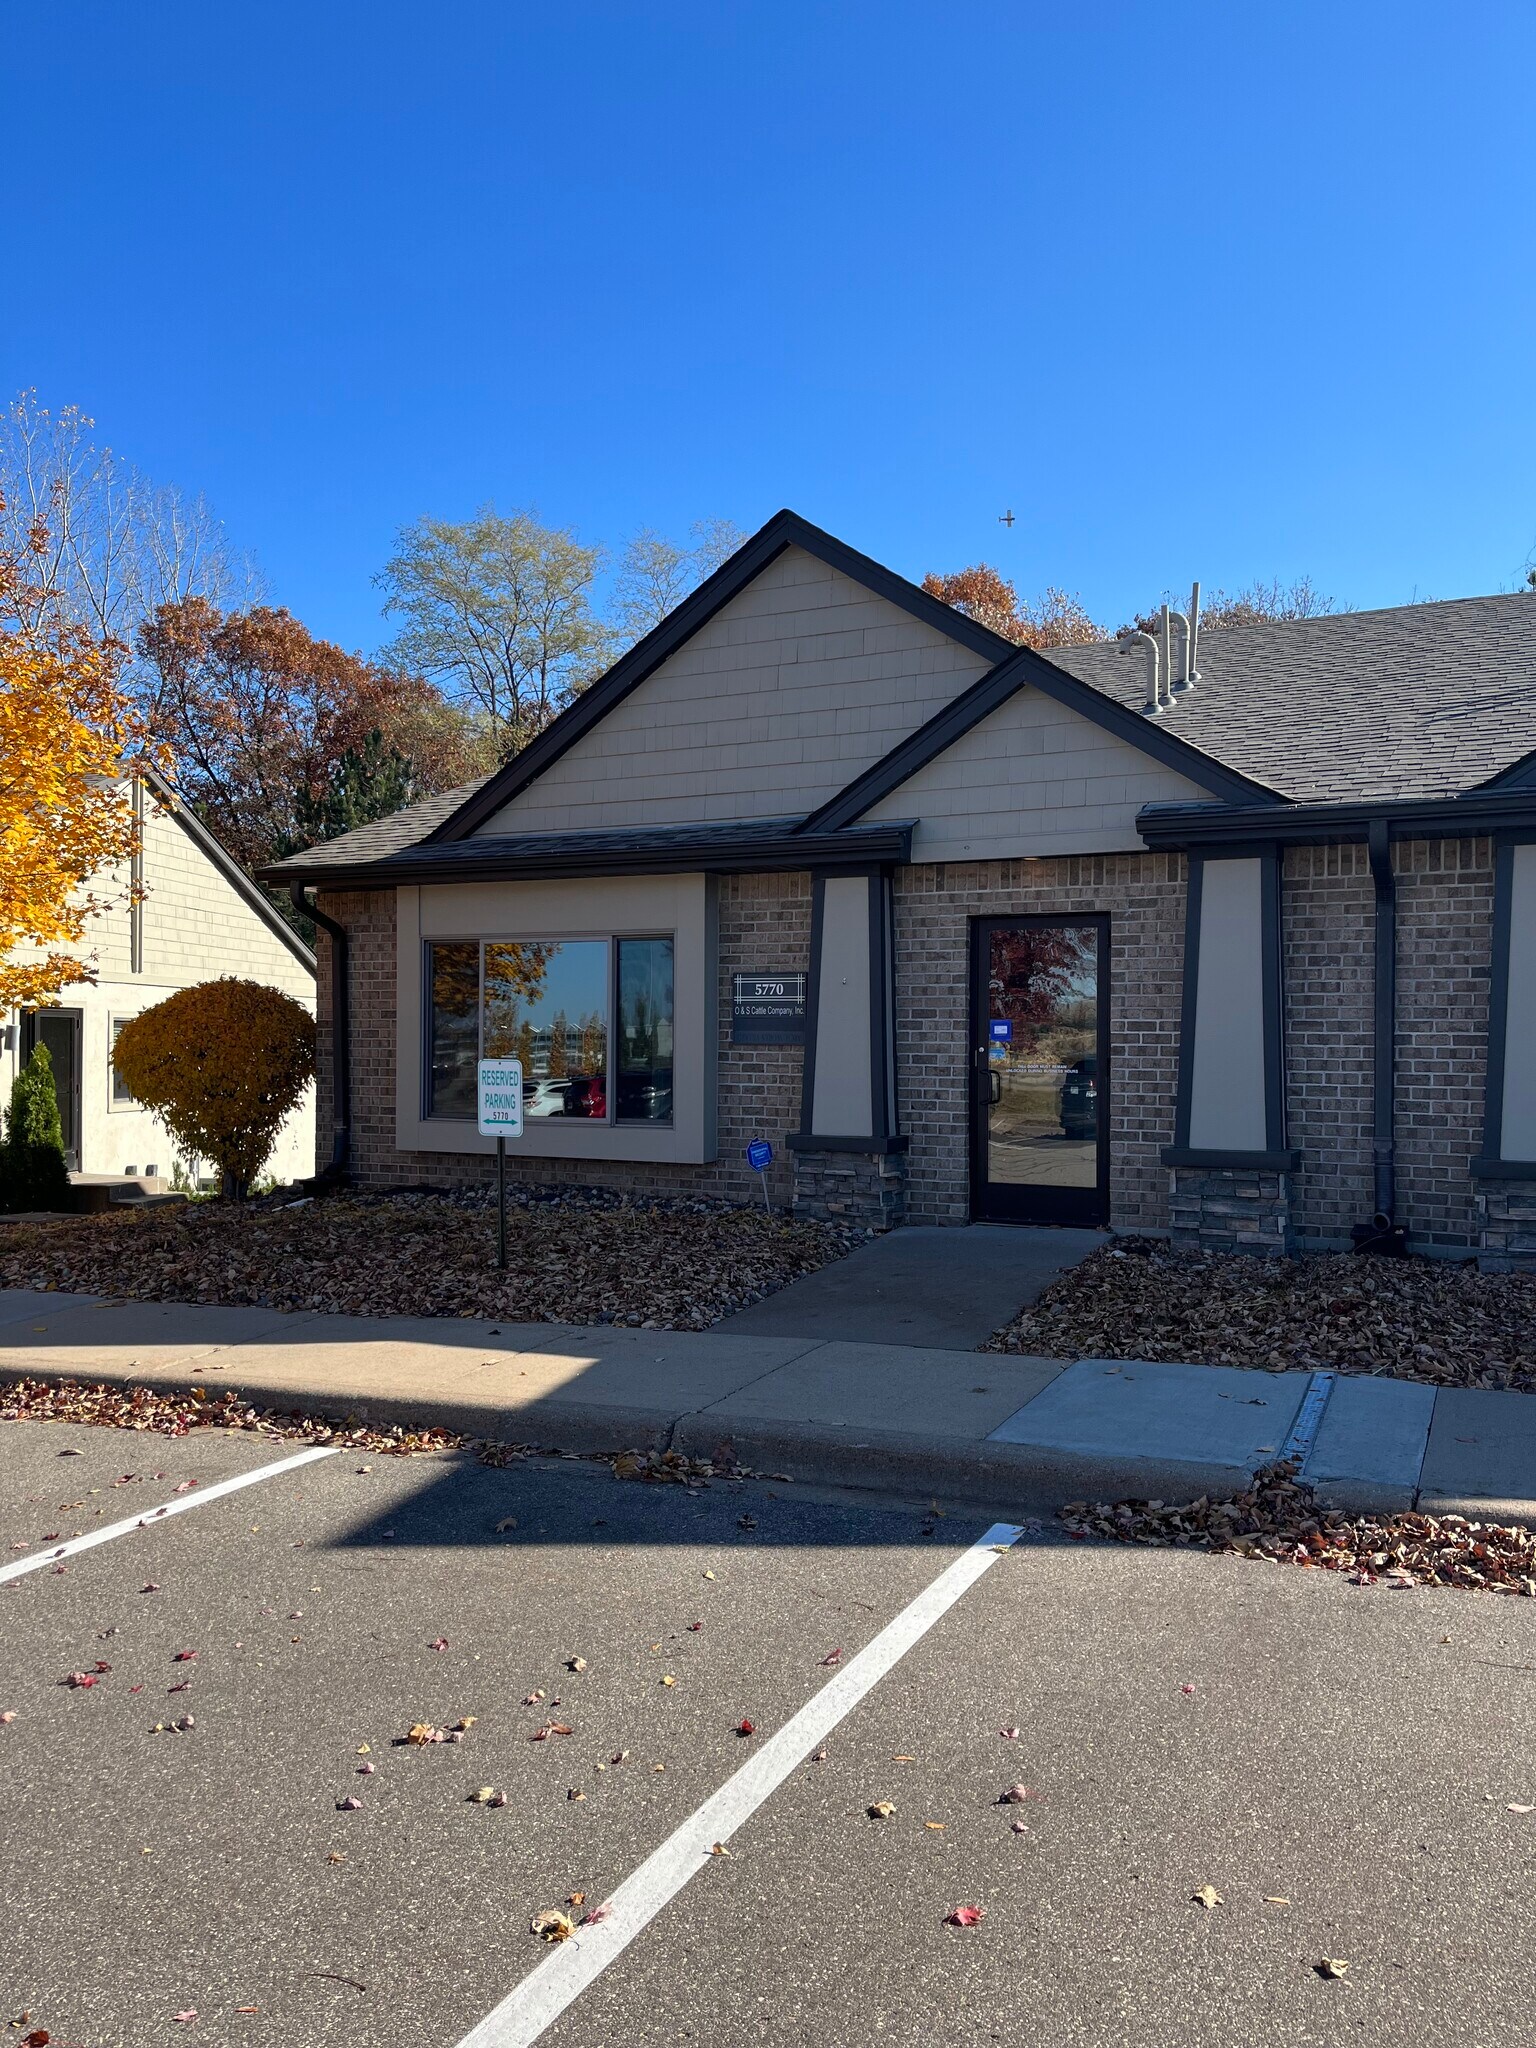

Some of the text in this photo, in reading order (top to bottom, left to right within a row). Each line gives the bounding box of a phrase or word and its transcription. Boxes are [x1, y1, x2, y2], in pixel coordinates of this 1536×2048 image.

[755, 983, 784, 995] 5770
[734, 1006, 804, 1016] O & S Cattle Company, Inc.
[481, 1069, 519, 1086] RESERVED
[485, 1093, 516, 1110] PARKING
[493, 1111, 509, 1120] 5770
